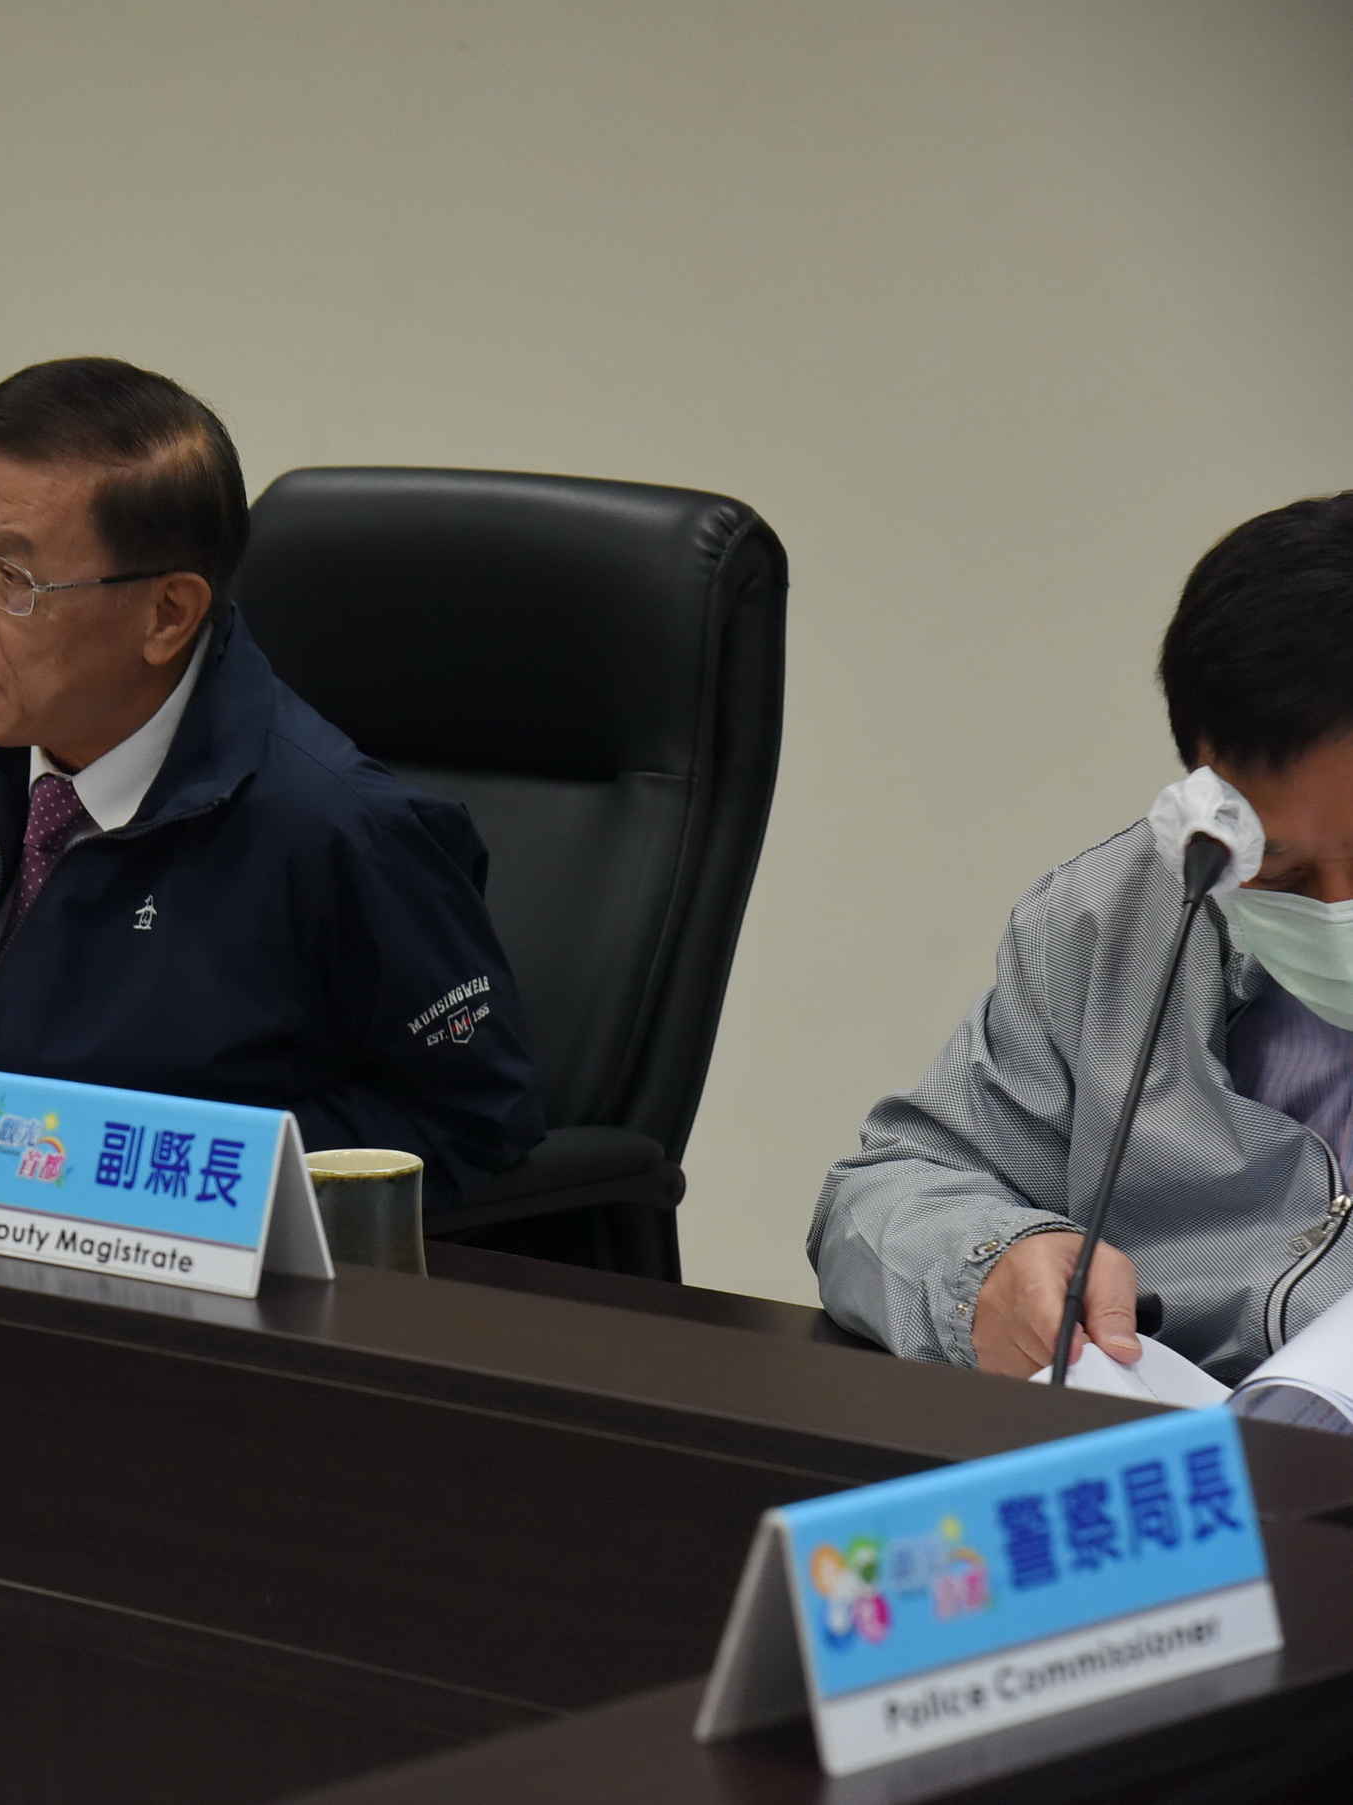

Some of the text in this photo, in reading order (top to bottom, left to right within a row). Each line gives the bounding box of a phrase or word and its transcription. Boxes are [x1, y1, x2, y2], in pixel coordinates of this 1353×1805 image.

[407, 975, 491, 1035] MUNSINGWEAR
[426, 1002, 490, 1047] EST. M 1955
[94, 1120, 246, 1208] 副縣長
[55, 1229, 194, 1274] Magistrate
[996, 1444, 1242, 1592] 警察局長
[883, 1615, 1222, 1733] Police Commissioner
